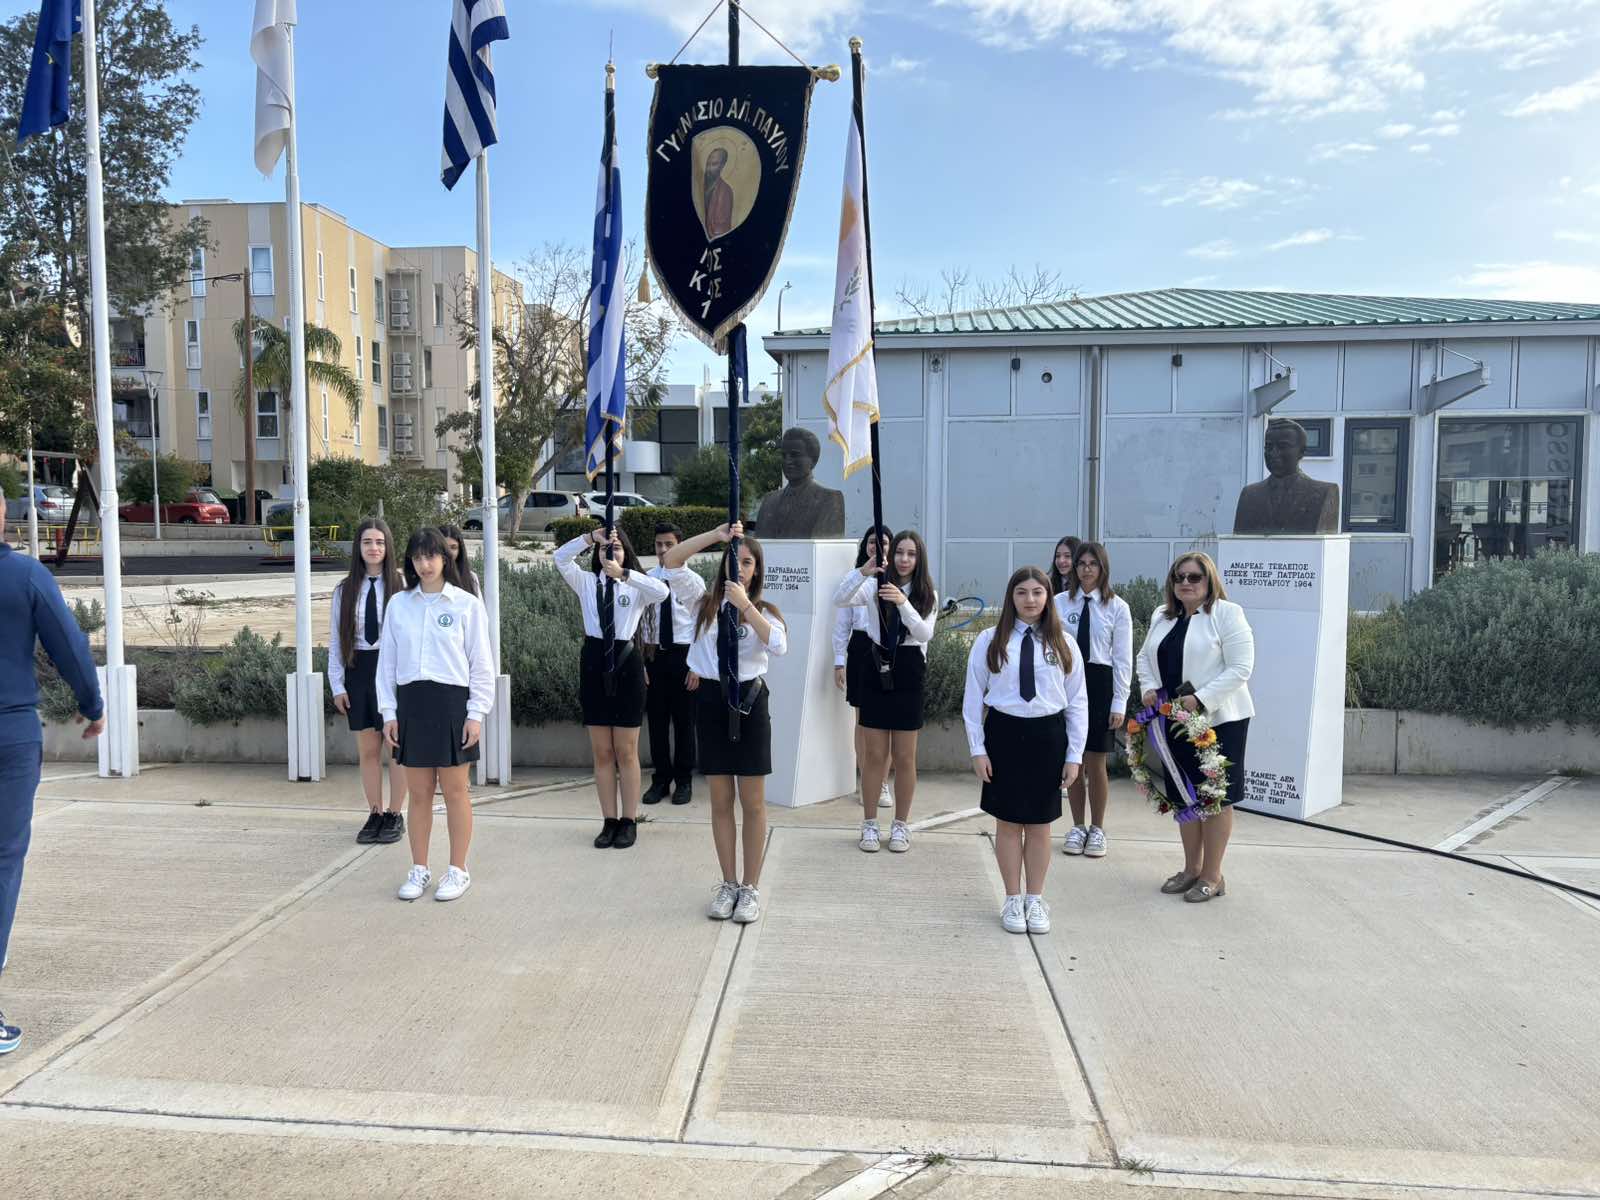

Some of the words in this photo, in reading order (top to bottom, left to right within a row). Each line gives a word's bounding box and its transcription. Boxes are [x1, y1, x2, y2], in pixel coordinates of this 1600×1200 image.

[752, 107, 790, 175] ΠΑΥΛΟΥ
[1230, 562, 1264, 570] ΑΝΔΡΕΑΣ
[1252, 570, 1273, 578] ΥΠΕΡ
[1277, 571, 1316, 579] ΠΑΤΡΙΔΟΣ
[1239, 578, 1291, 587] ΦΕΒΡΟΥΑΡΙΟΥ
[1294, 580, 1313, 588] 1964
[1250, 771, 1277, 781] ΚΑΝΕΙΣ
[1280, 775, 1295, 783] ΔΕΝ
[1286, 783, 1296, 792] ΝΑ
[1270, 789, 1300, 800] ΠΑΤΡΙΔΑ
